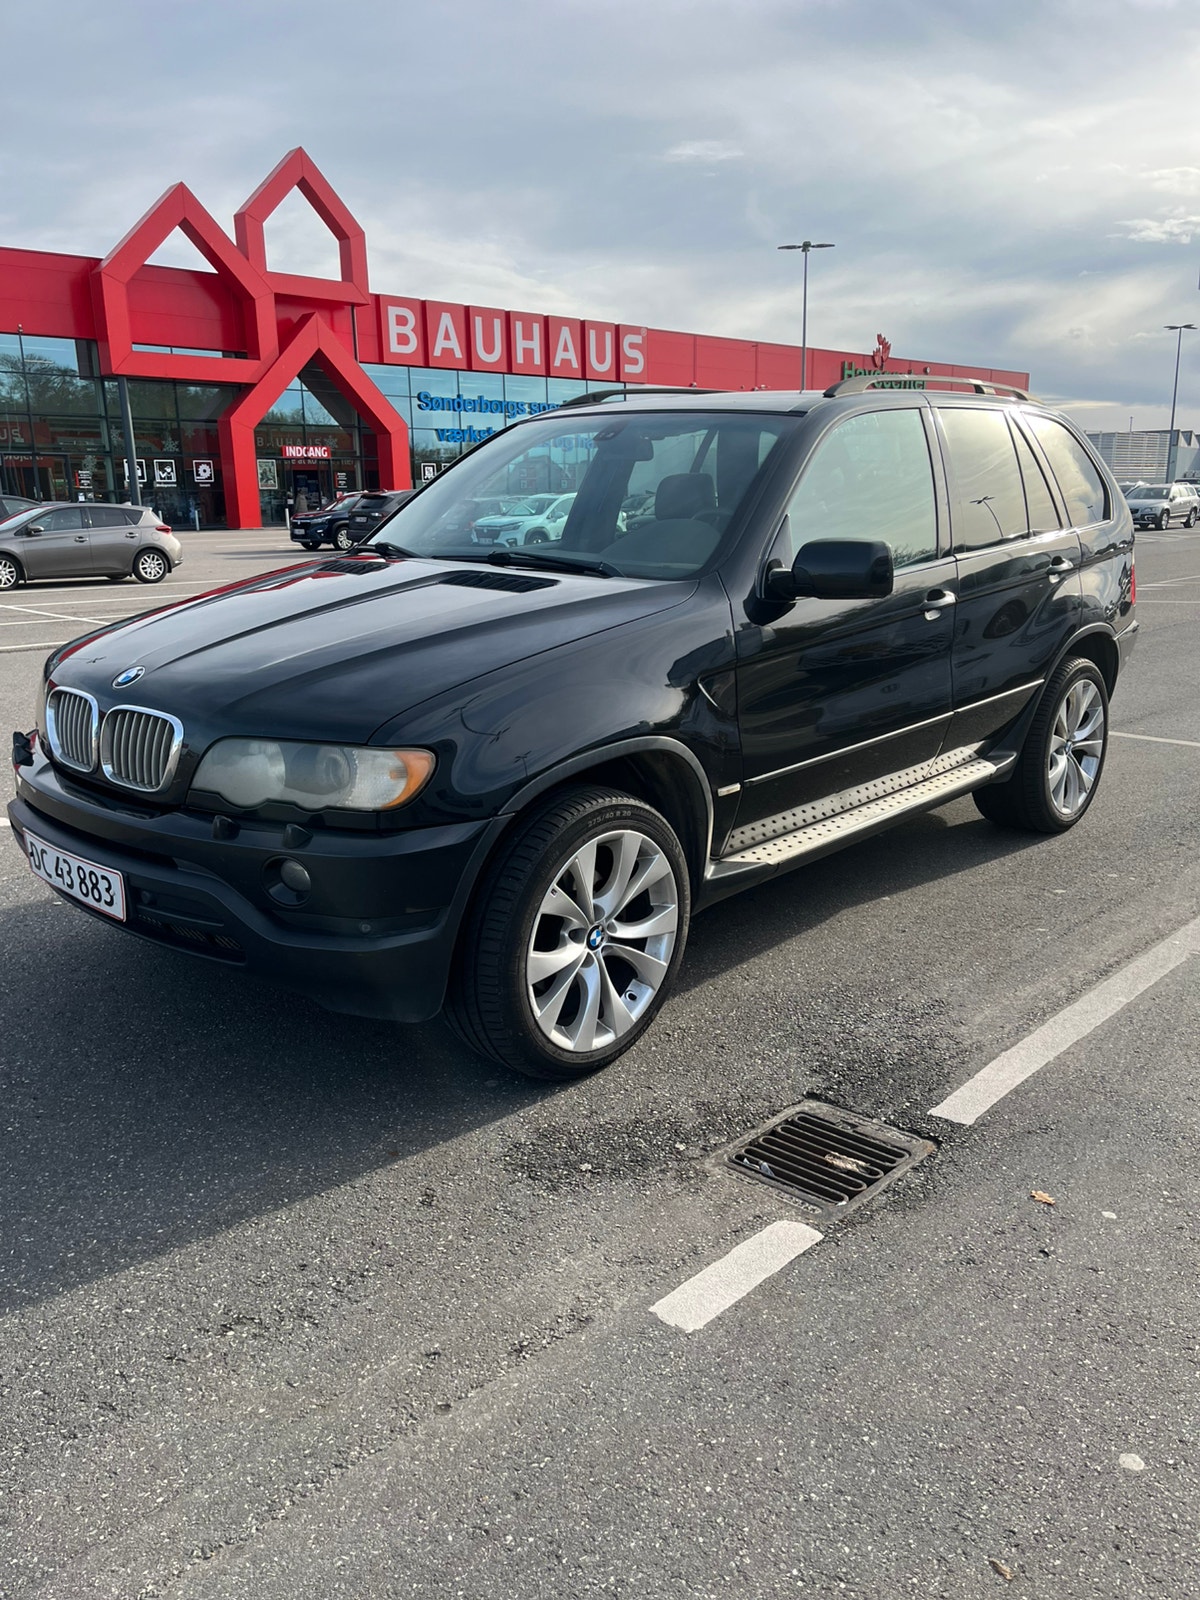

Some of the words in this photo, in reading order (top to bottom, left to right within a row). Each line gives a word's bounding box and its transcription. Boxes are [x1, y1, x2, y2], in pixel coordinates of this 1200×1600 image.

[387, 305, 645, 374] BAUHAUS
[843, 360, 927, 390] Hecente
[418, 391, 527, 418] Sønderborgs
[30, 841, 52, 879] DC
[55, 856, 74, 890] 43
[77, 865, 114, 907] 883
